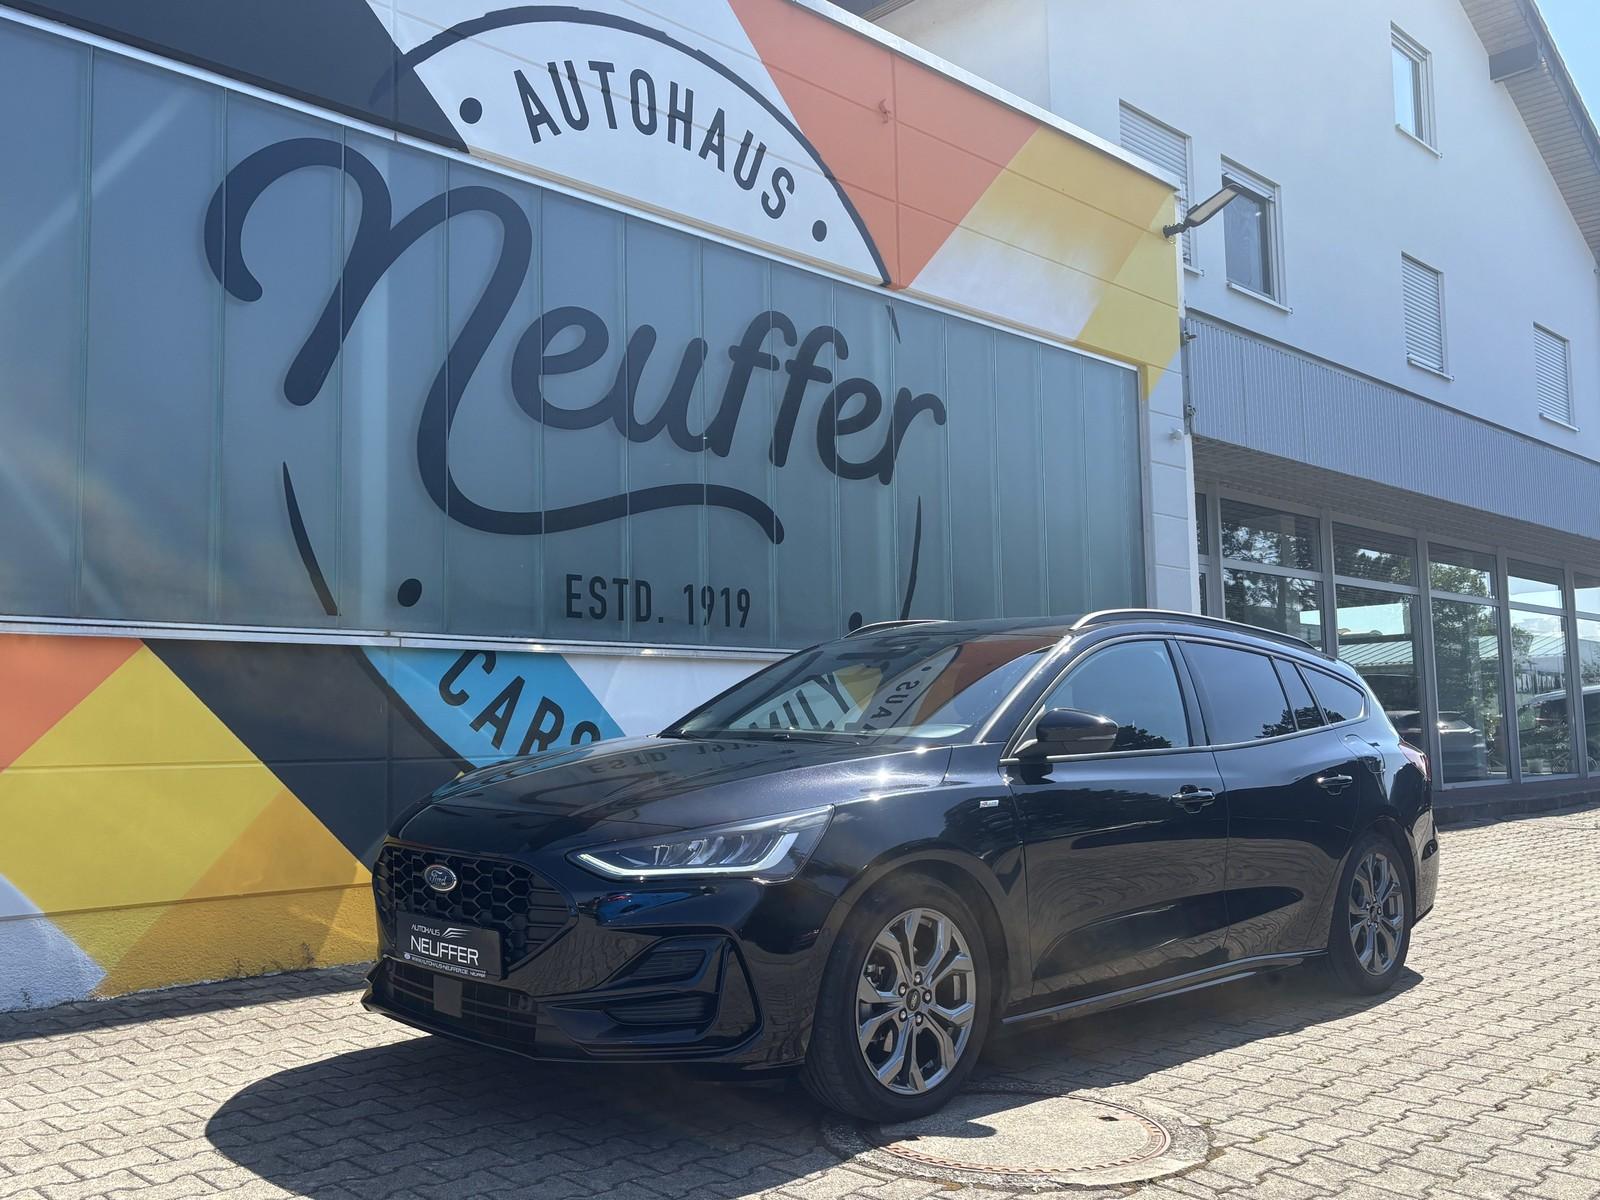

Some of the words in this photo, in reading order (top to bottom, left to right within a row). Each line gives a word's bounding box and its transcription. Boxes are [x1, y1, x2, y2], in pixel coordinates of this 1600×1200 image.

[513, 60, 795, 219] AUTOHAUS
[566, 573, 664, 622] ESTD.
[683, 583, 750, 628] 1919
[410, 935, 479, 966] NEUFFER
[411, 924, 441, 936] AUTOHAUS
